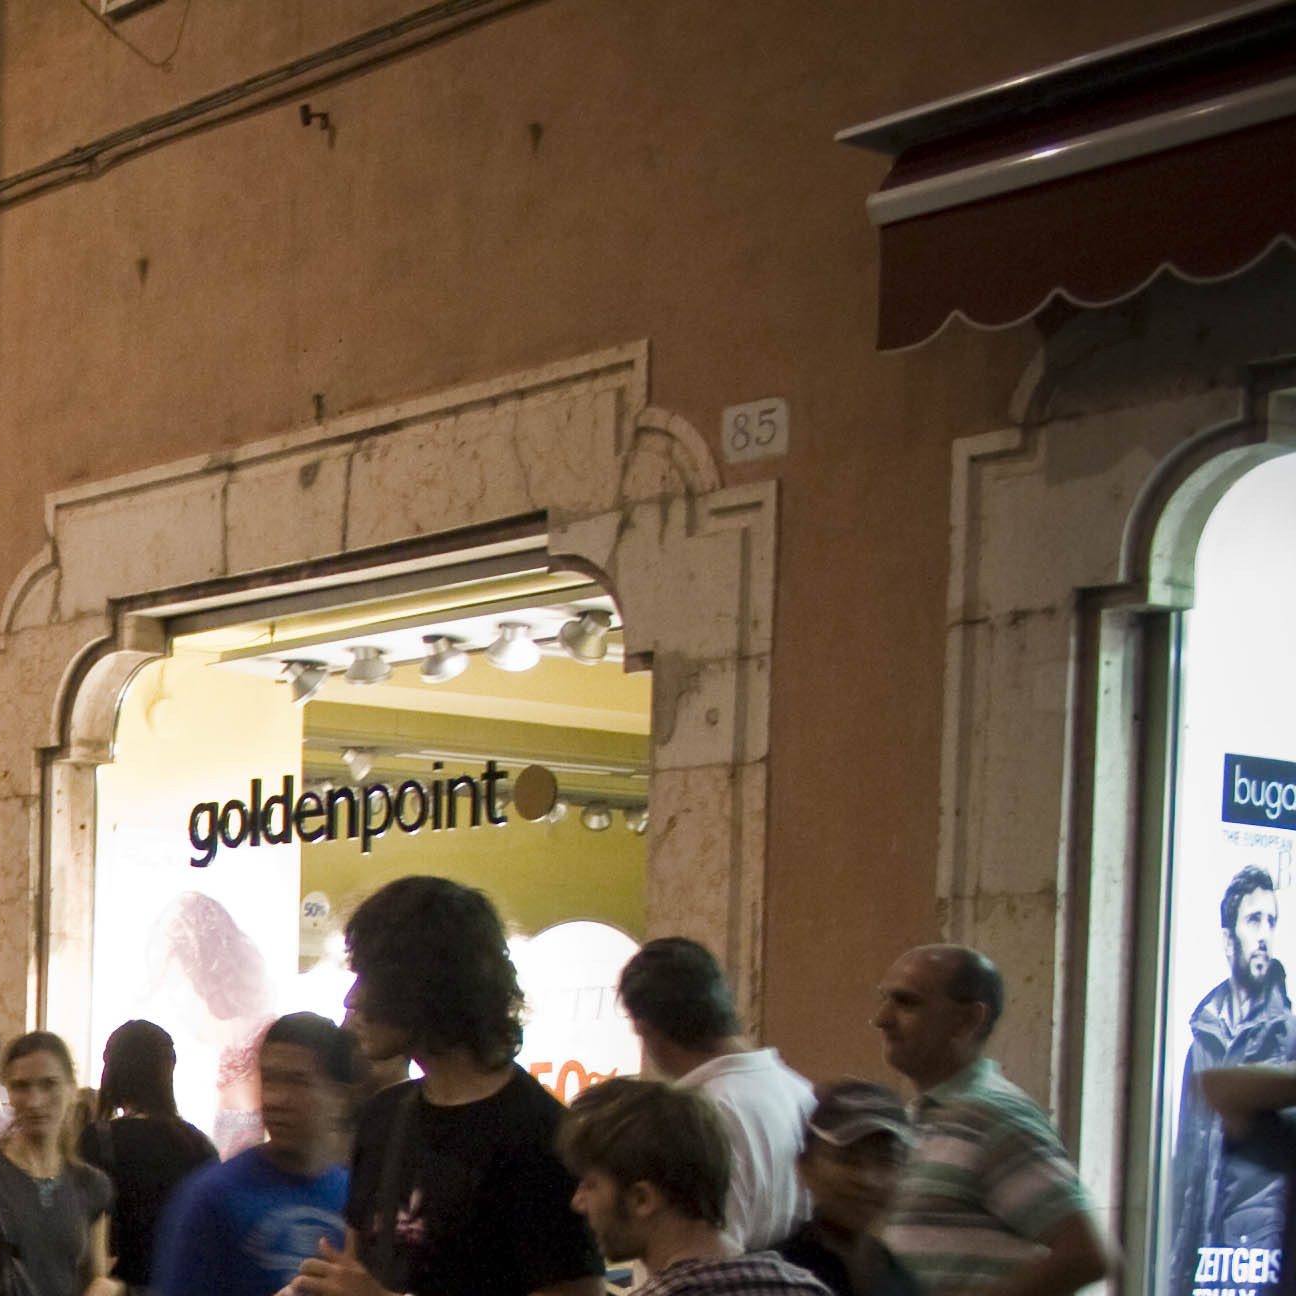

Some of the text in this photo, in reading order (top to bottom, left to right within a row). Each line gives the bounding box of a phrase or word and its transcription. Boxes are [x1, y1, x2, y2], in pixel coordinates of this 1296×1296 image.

[730, 407, 777, 451] 85
[188, 760, 508, 868] goldenpoint
[1233, 763, 1296, 820] buga
